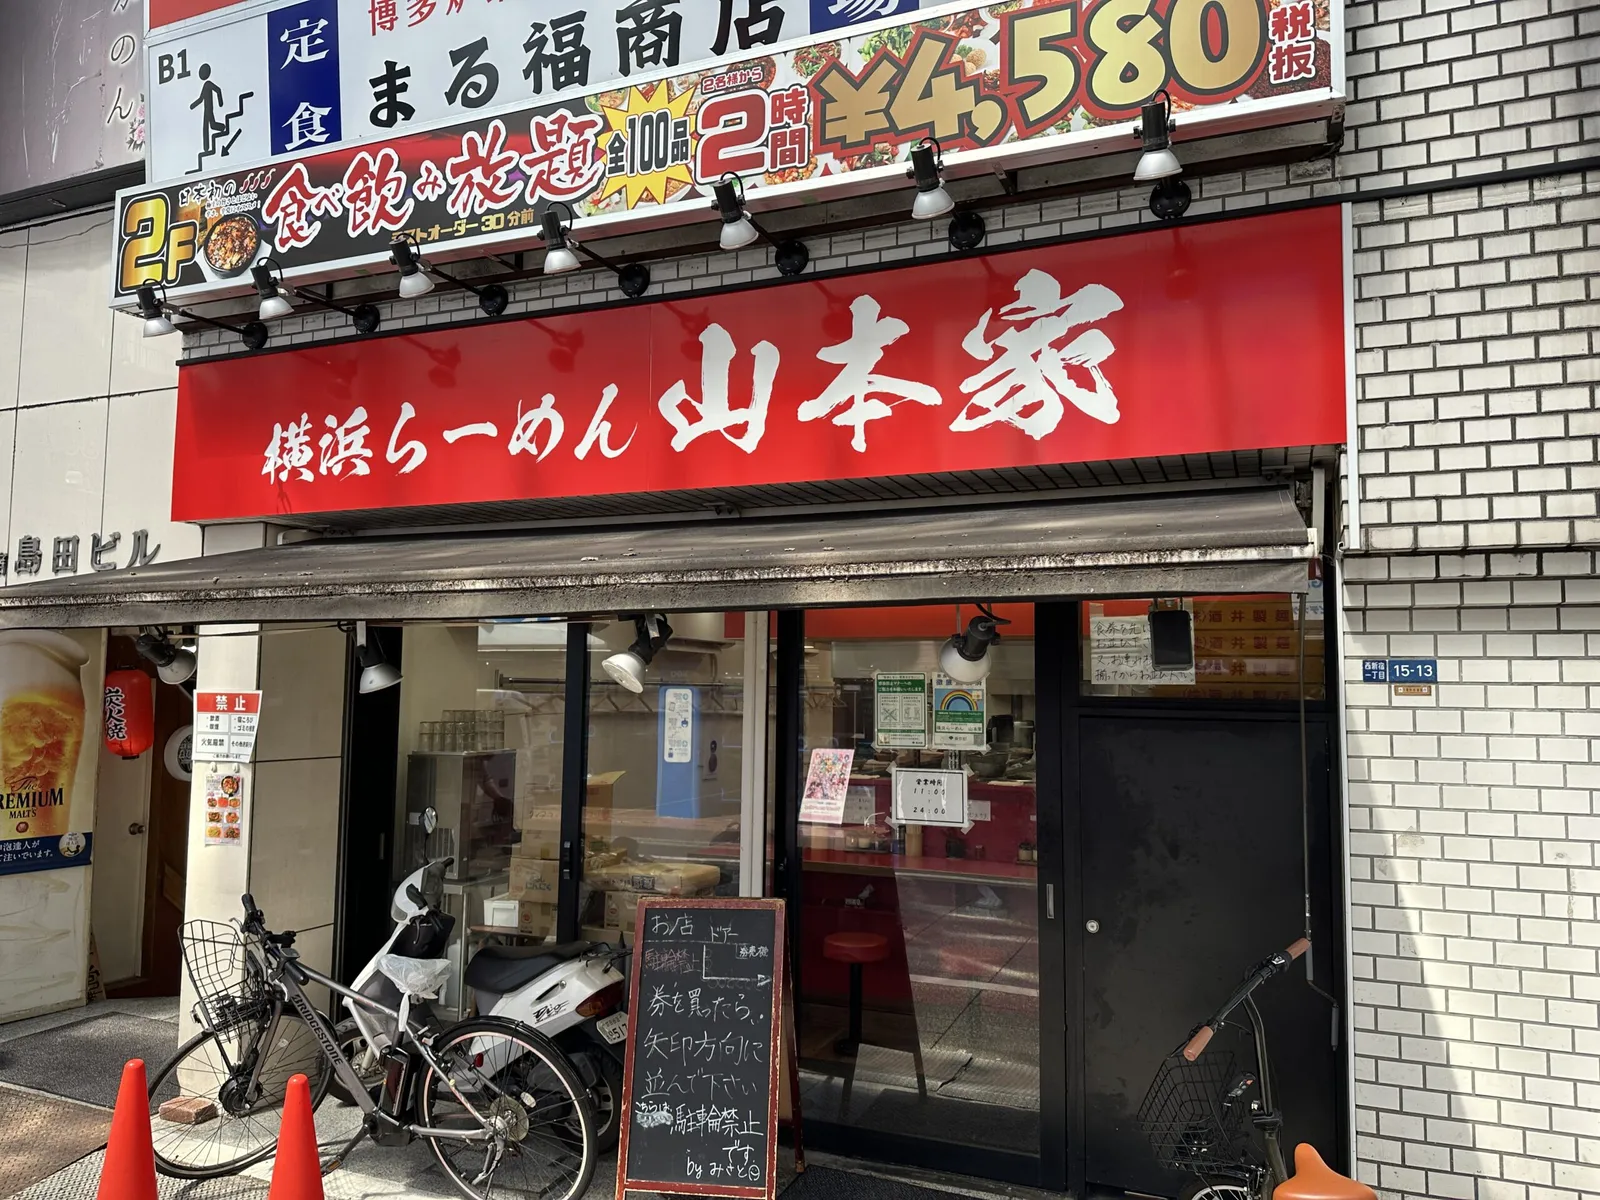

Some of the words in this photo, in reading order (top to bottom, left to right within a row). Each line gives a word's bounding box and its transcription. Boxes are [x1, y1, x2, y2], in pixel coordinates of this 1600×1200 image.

[1269, 4, 1315, 84] 税抜
[158, 49, 191, 85] B1
[368, 0, 786, 128] まる福商店
[702, 66, 764, 93] 2名様から
[818, 0, 1264, 145] ¥4,580
[279, 18, 333, 152] 定食
[607, 110, 690, 176] 全100品
[699, 86, 810, 183] 2時間
[179, 179, 237, 207] 日本初の
[263, 109, 604, 253] 食べ飲み放題
[121, 194, 199, 290] 2F
[261, 383, 638, 484] 横浜らーめん
[658, 268, 1124, 453] 山本家
[0, 529, 161, 575] 島田ビル
[1364, 662, 1385, 670] 西新宿
[1365, 671, 1385, 680] 一丁目
[1393, 664, 1433, 677] 15-13
[105, 686, 127, 741] 炭火焼
[215, 694, 246, 711] 禁止
[9, 807, 37, 819] MALT'S
[0, 840, 41, 851] 泡達人が
[651, 913, 693, 935] お店
[291, 994, 344, 1066] BRIDGESTONE
[644, 1028, 763, 1066] 矢印方向に
[641, 1067, 758, 1100] 並んで下さい
[670, 1103, 764, 1137] 駐輪禁止
[686, 1156, 703, 1179] by
[709, 1162, 748, 1178] みさと
